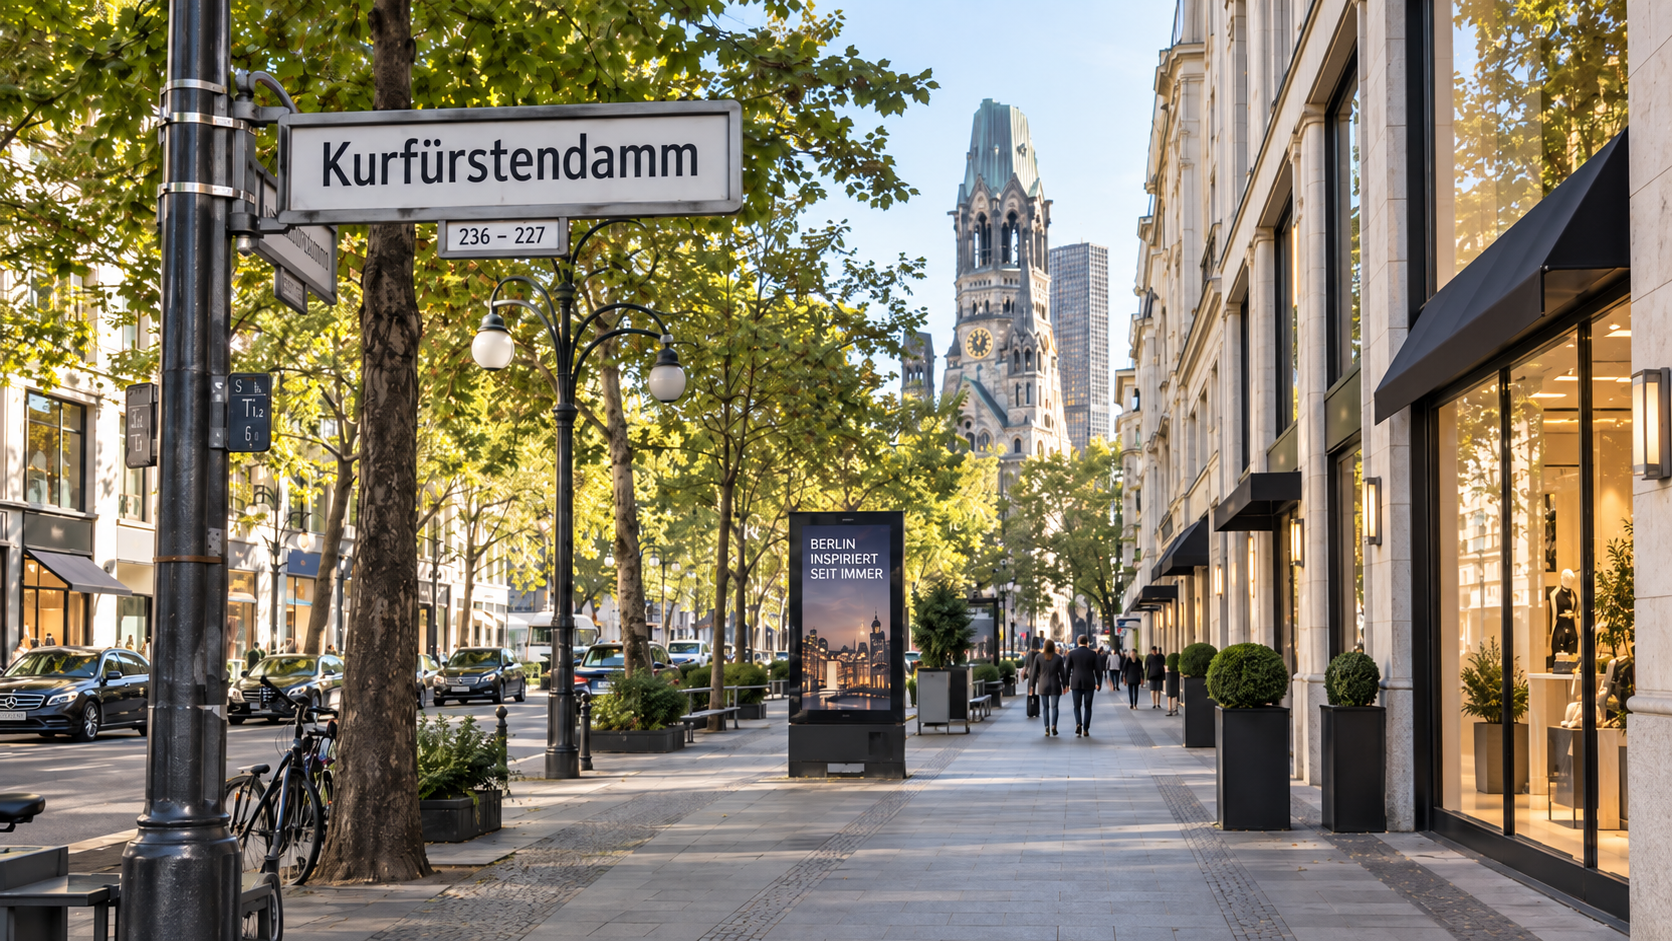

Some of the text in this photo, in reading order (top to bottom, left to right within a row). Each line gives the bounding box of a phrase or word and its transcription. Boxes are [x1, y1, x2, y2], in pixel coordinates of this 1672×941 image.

[323, 133, 699, 187] Kurfürstendamm
[459, 227, 490, 245] 236
[514, 226, 545, 244] 227
[810, 538, 856, 550] BERLIN
[810, 553, 879, 565] INSPIRIERT
[810, 568, 883, 580] SEIT IMMER
